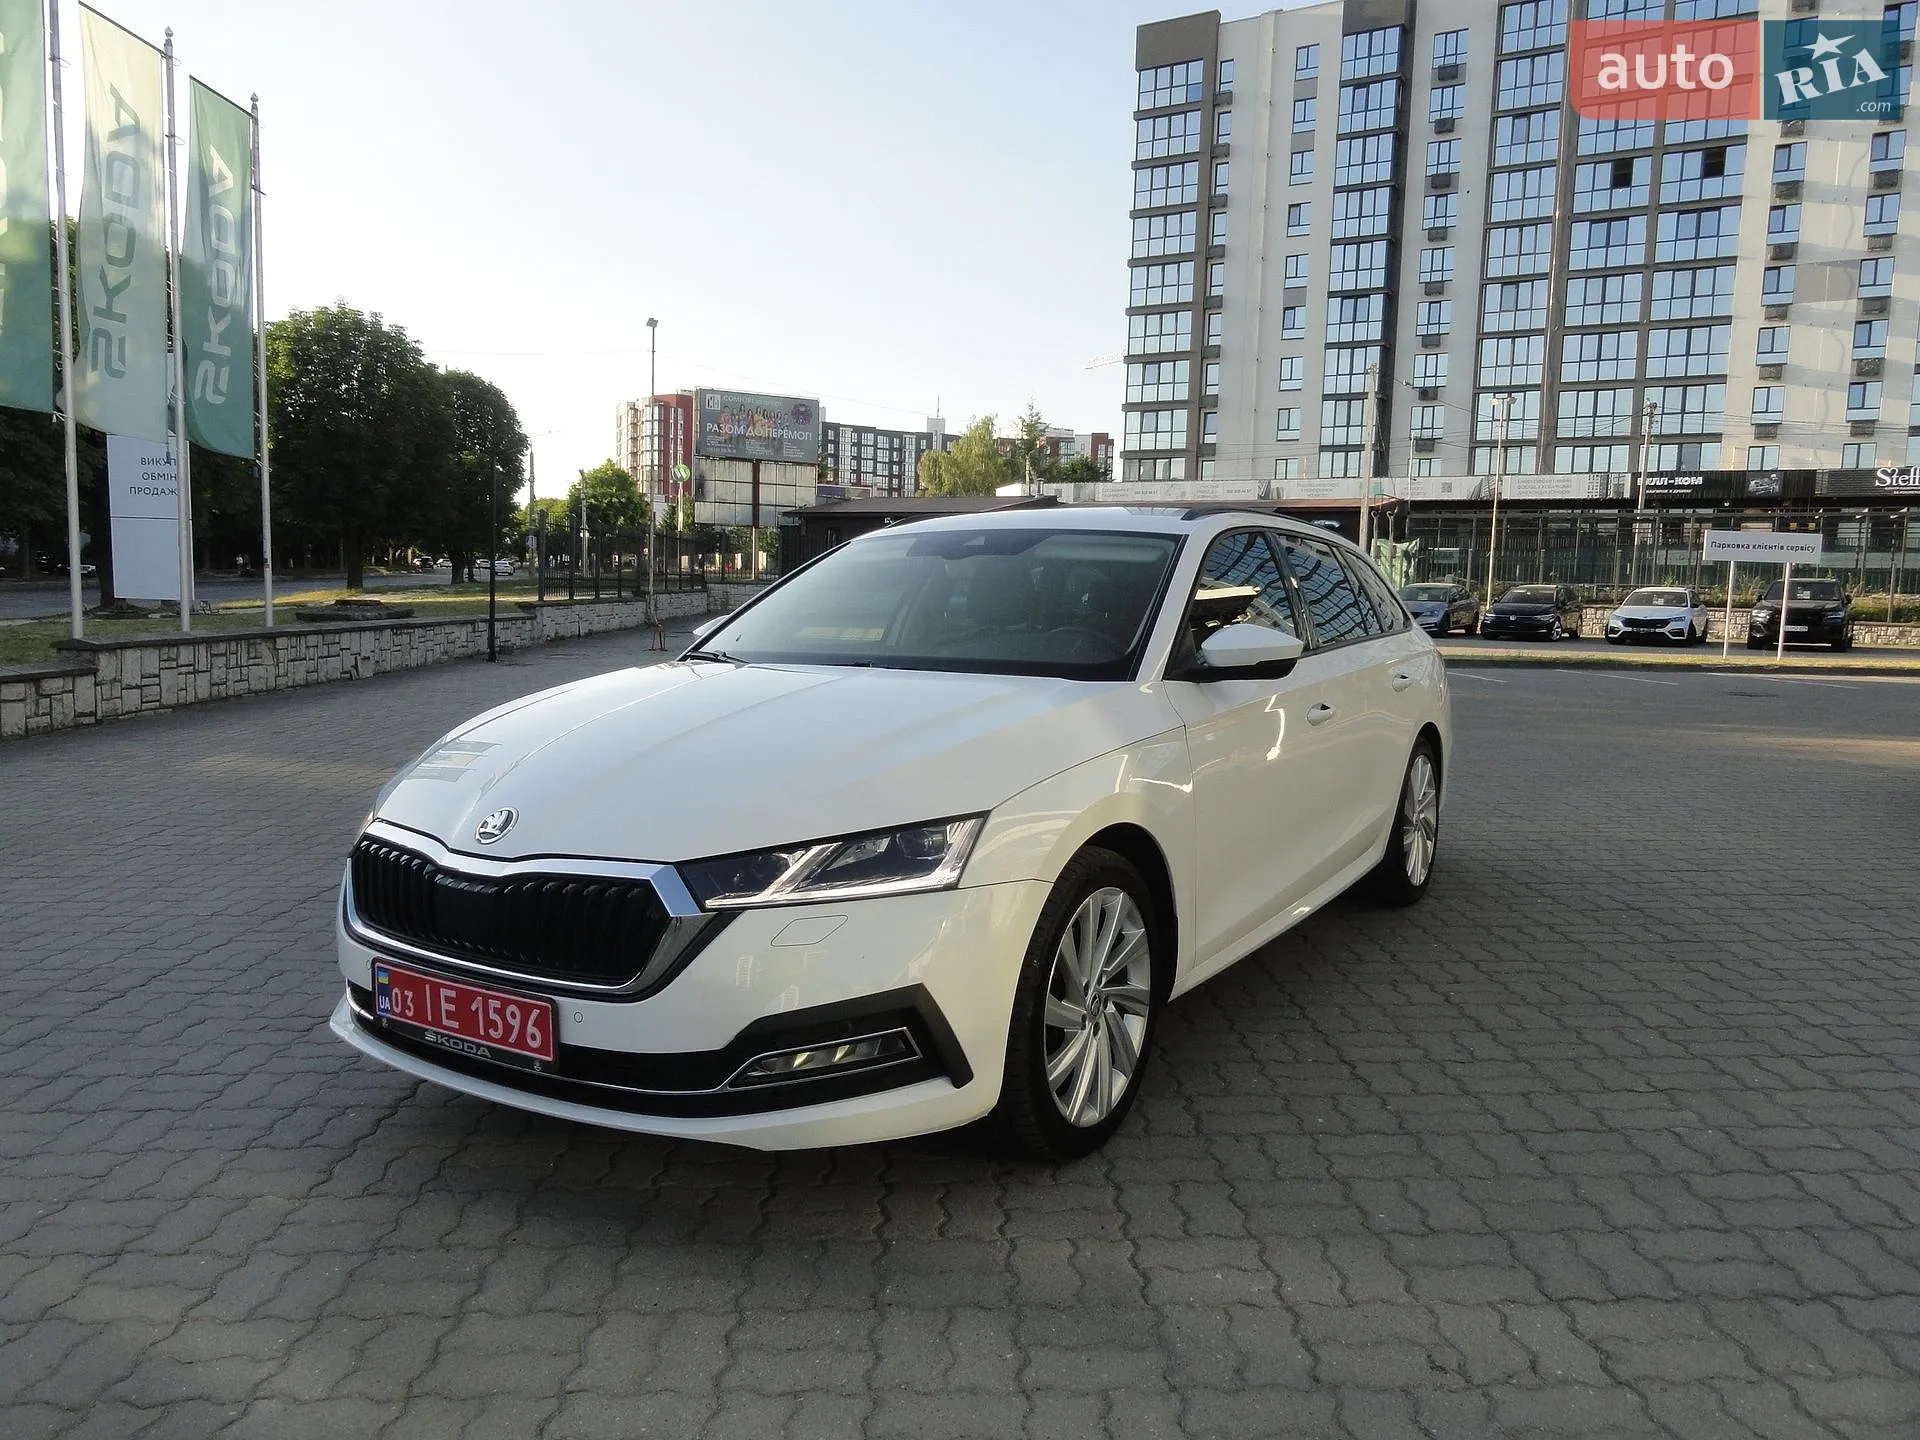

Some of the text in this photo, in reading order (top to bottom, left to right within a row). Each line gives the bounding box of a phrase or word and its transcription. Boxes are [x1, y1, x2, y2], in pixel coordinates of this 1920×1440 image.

[706, 422, 744, 435] РАЗОМ
[746, 425, 763, 437] ДО
[142, 472, 177, 481] ОБМІН
[129, 486, 178, 496] ПРОДАЖ
[1710, 541, 1816, 553] Парковка клієнтів сервісу
[379, 984, 542, 1049] UA 03 IE 1596
